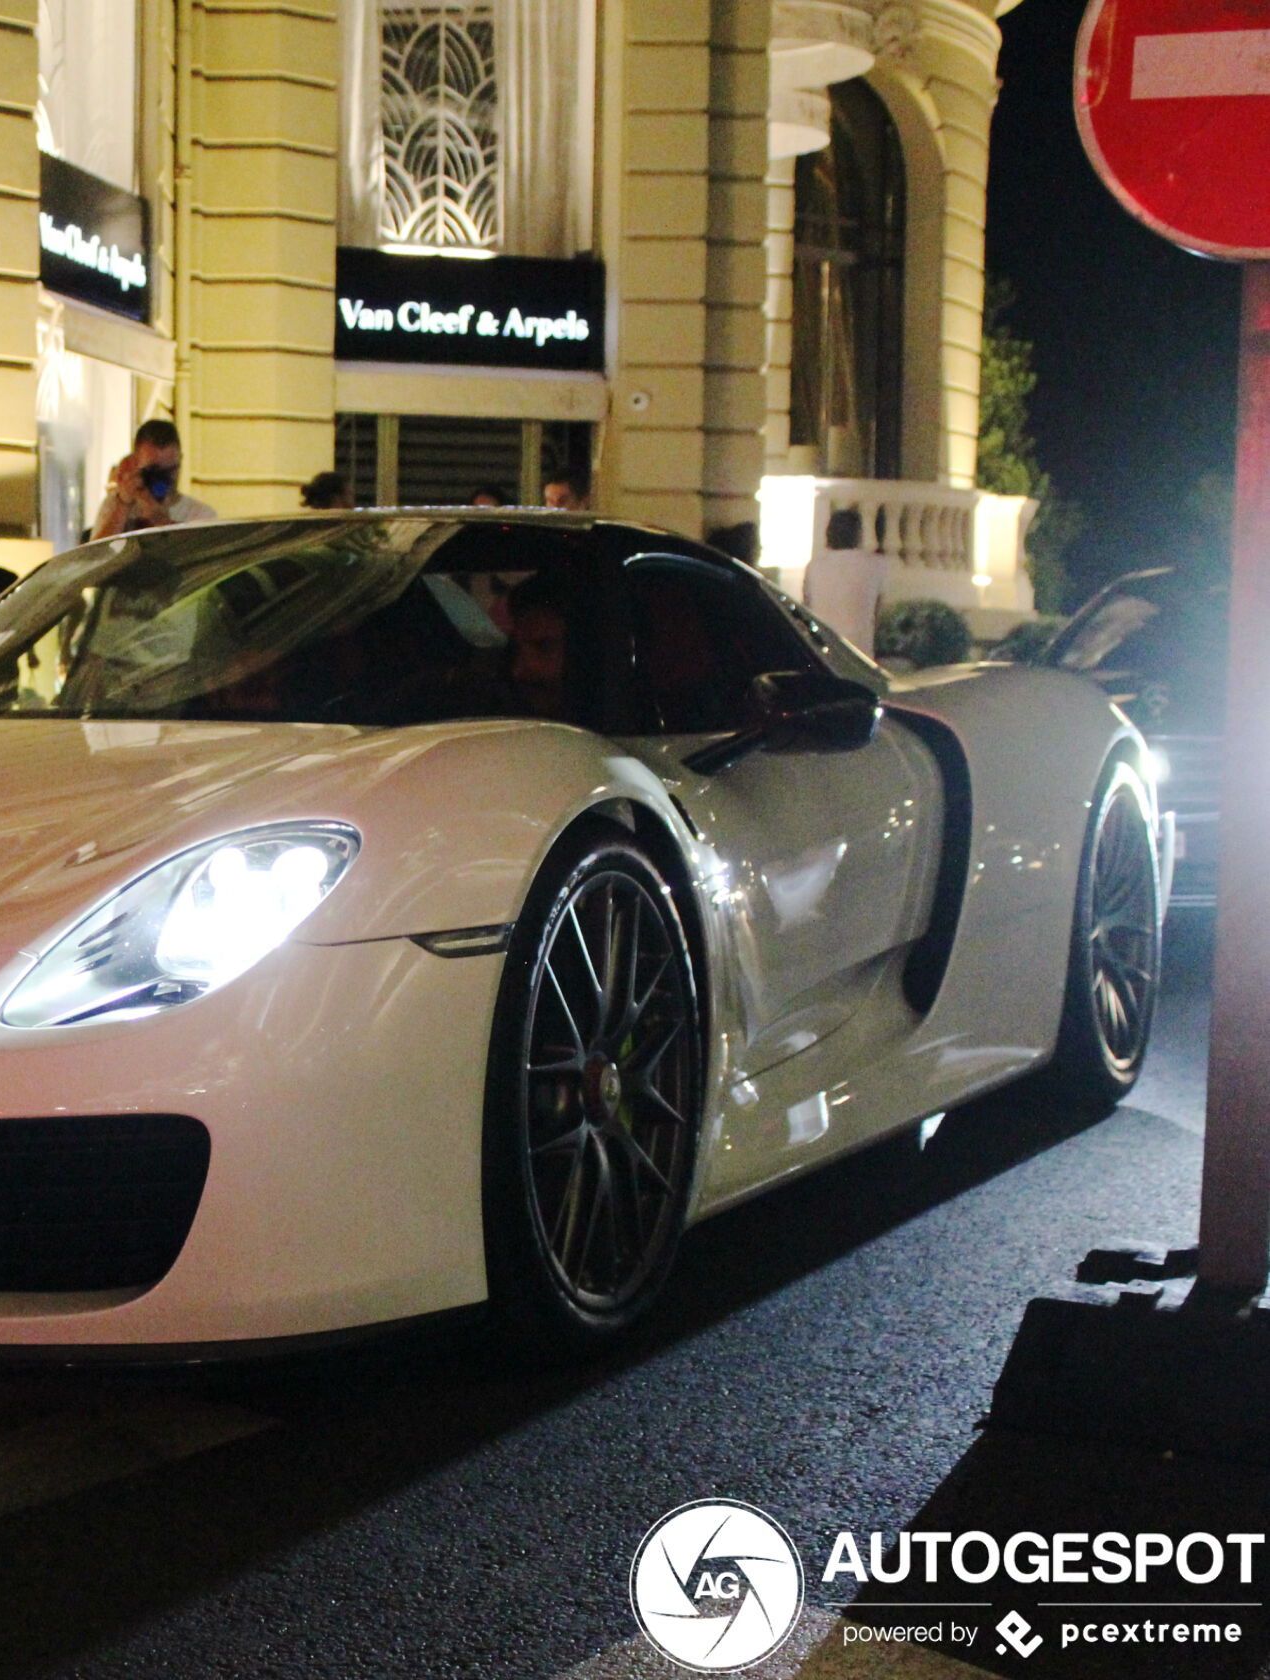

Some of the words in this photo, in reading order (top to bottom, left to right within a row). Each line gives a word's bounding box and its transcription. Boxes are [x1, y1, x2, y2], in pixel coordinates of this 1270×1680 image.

[338, 298, 394, 331] Van
[397, 301, 475, 334] Cleef
[476, 311, 500, 336] &
[502, 307, 590, 346] Arpels
